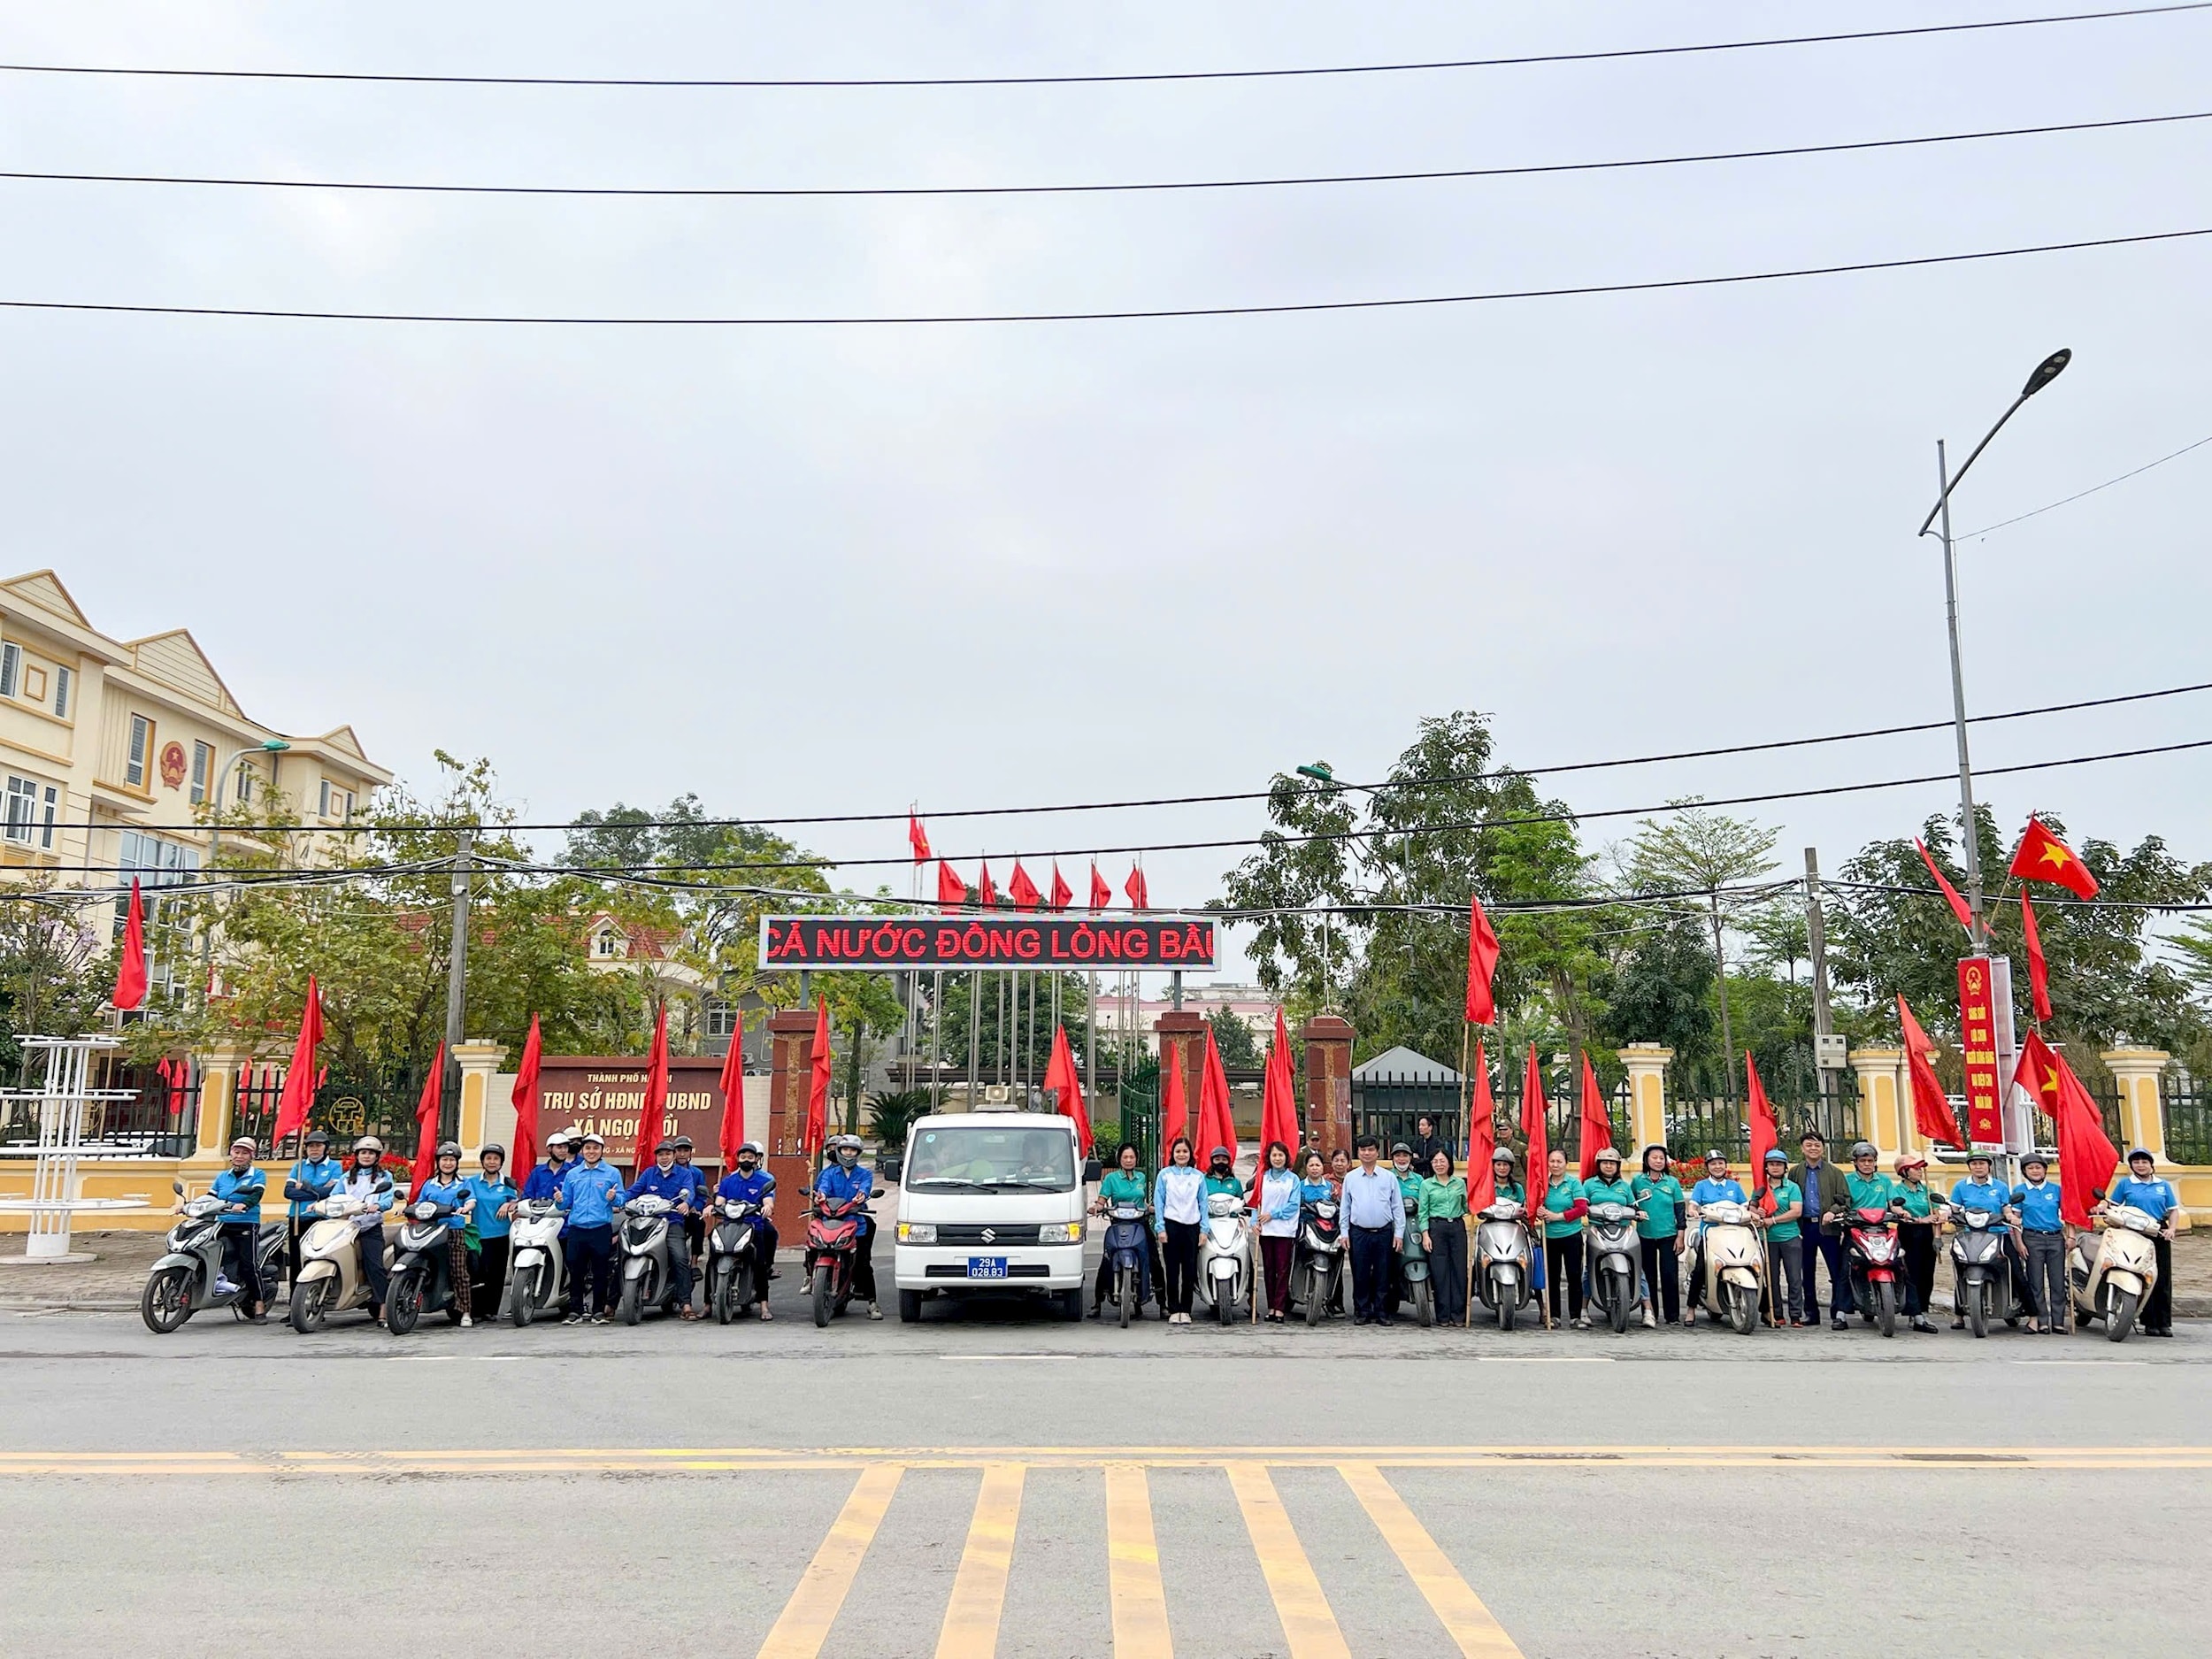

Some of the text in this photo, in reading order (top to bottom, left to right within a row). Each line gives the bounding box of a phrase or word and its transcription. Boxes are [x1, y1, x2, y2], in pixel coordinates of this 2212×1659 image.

[767, 923, 807, 957] CẢ
[816, 922, 926, 957] NƯỚC
[934, 922, 1041, 957] ĐỒNG
[1051, 923, 1148, 958] LÒNG
[588, 1071, 618, 1083] THÀNH
[619, 1071, 639, 1083] PHỐ
[543, 1092, 575, 1113] TRỤ
[578, 1086, 603, 1110] SỞ
[665, 1092, 711, 1110] UBND
[573, 1115, 595, 1136] XÃ
[663, 1113, 678, 1137] ỒI
[979, 1258, 996, 1267] 29A
[972, 1267, 1003, 1277] 028.83
